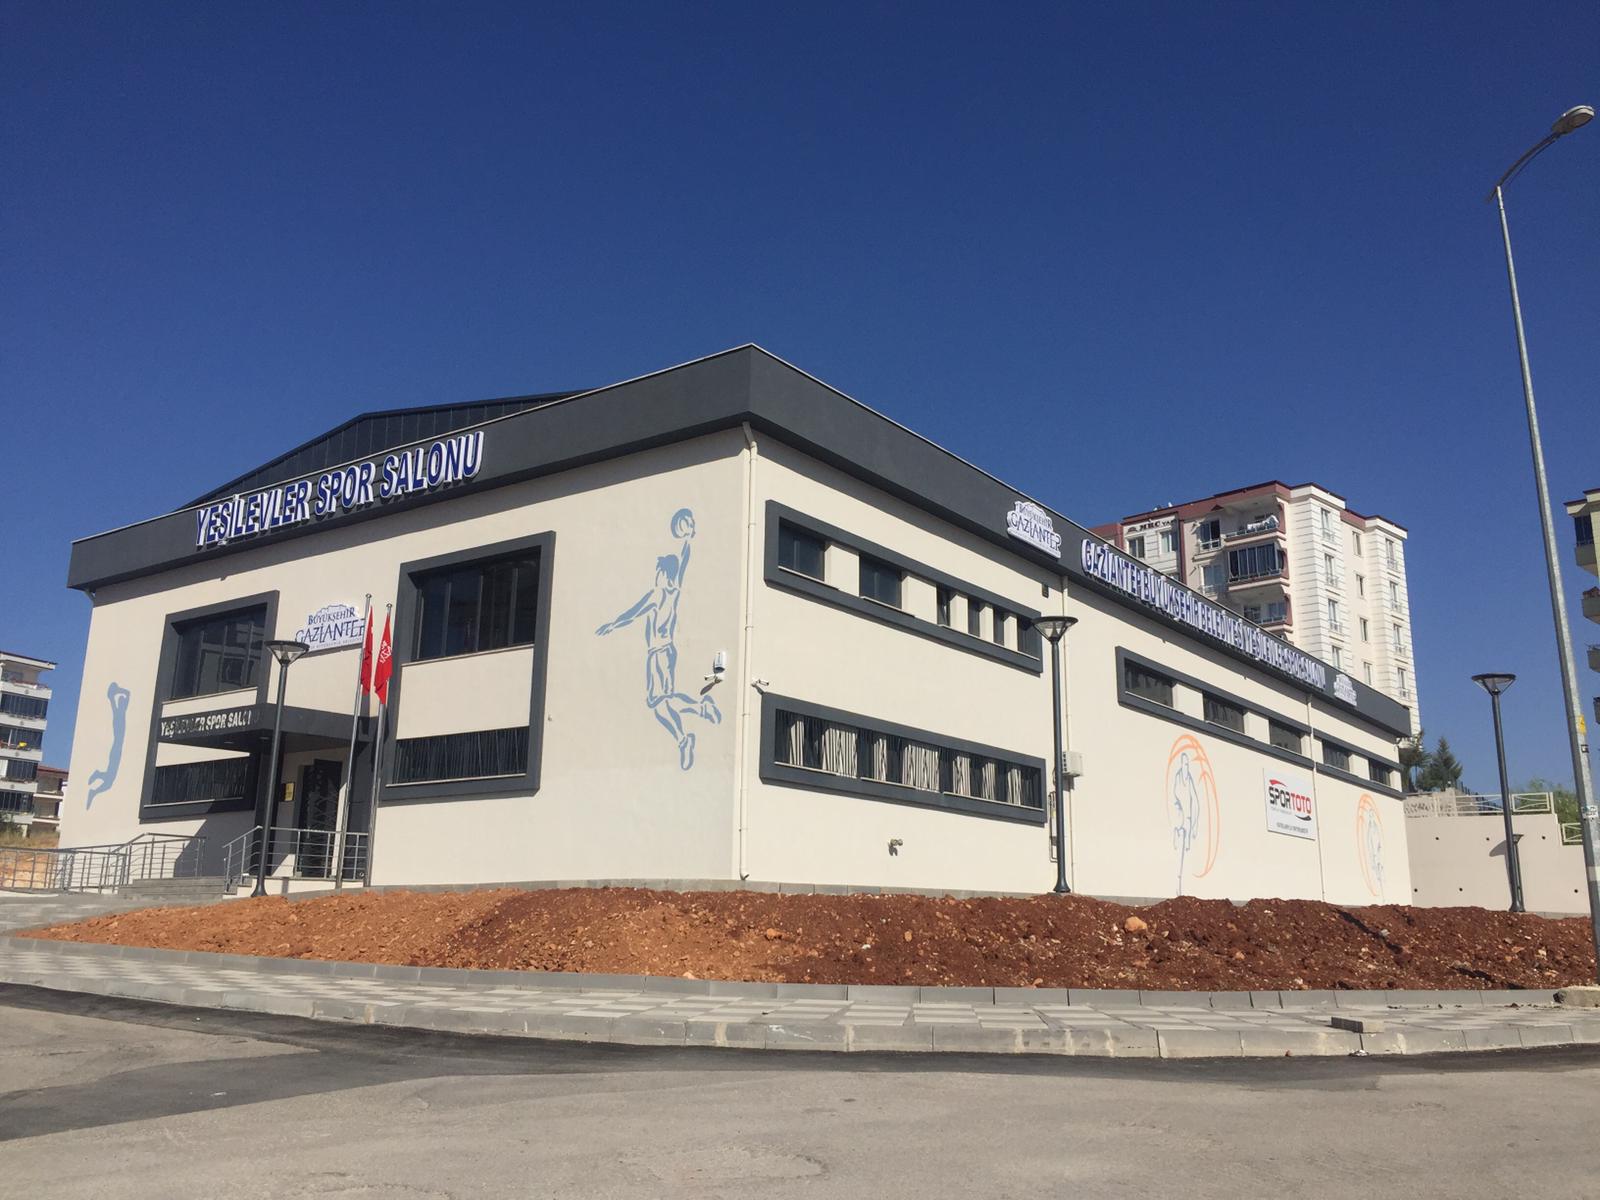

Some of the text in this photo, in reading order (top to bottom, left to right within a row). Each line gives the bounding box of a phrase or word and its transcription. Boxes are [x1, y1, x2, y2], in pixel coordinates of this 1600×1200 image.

[315, 462, 376, 516] SPOR
[381, 430, 485, 498] SALONU
[1081, 539, 1141, 597] GAZİANTEP
[1140, 568, 1199, 627] BÜYÜKŞEHİR
[308, 607, 356, 626] BÜYÜKŞEHİR
[206, 712, 227, 731] SPOR
